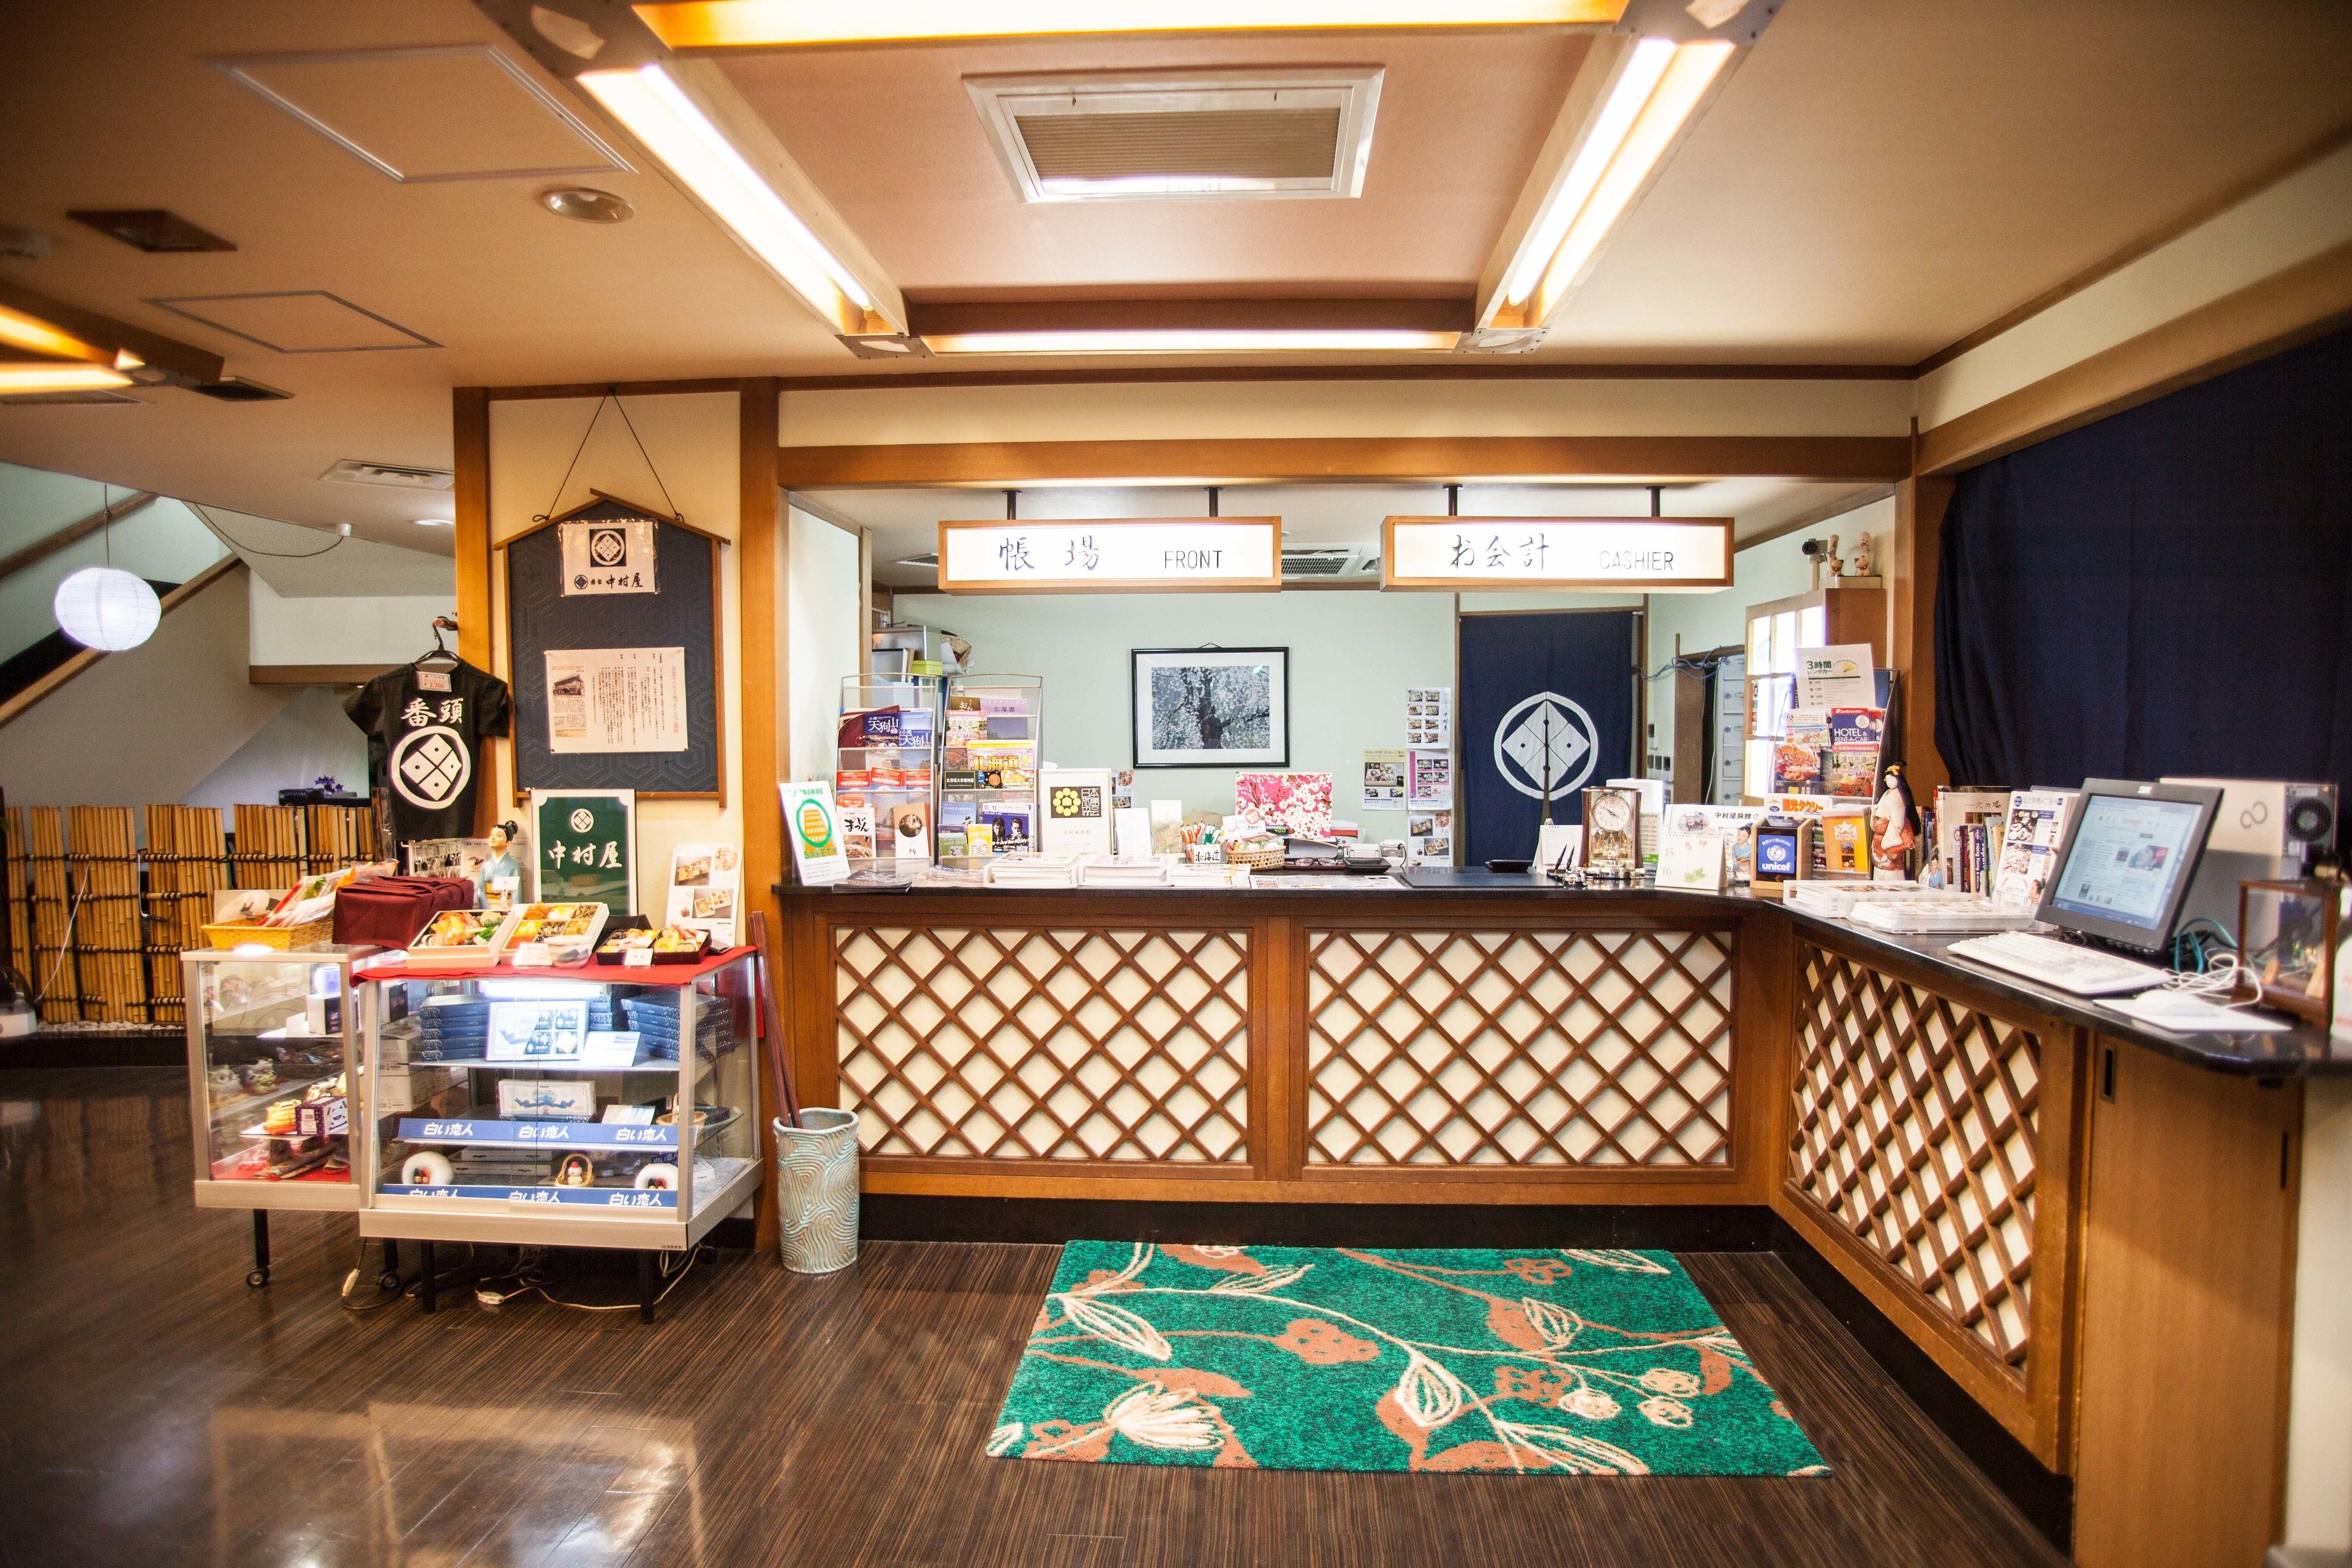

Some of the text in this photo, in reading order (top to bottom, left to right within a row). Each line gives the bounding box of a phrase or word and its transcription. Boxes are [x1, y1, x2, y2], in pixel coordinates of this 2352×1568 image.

[1450, 533, 1550, 571] お会計
[1164, 550, 1223, 570] FRONT
[1600, 551, 1674, 571] CASHIER
[606, 572, 643, 589] 中村屋
[1806, 660, 1832, 669] 3時間
[401, 698, 464, 727] 番頭
[868, 717, 899, 733] 天狗山
[970, 755, 1021, 771] 北海道
[1081, 788, 1099, 797] 日本
[1081, 797, 1100, 807] 旅館
[1782, 798, 1824, 812] 観光タクシー
[1081, 806, 1100, 816] 協会
[548, 840, 623, 870] 中村屋
[804, 846, 838, 859] SAFETY
[1195, 850, 1220, 862] 北海道
[1665, 848, 1675, 858] 15
[1762, 861, 1791, 871] unicef
[424, 1122, 667, 1142] 白い恋人 白い恋人 白い恋人
[508, 1191, 560, 1203] 白い恋人
[609, 1193, 663, 1206] 白い恋人
